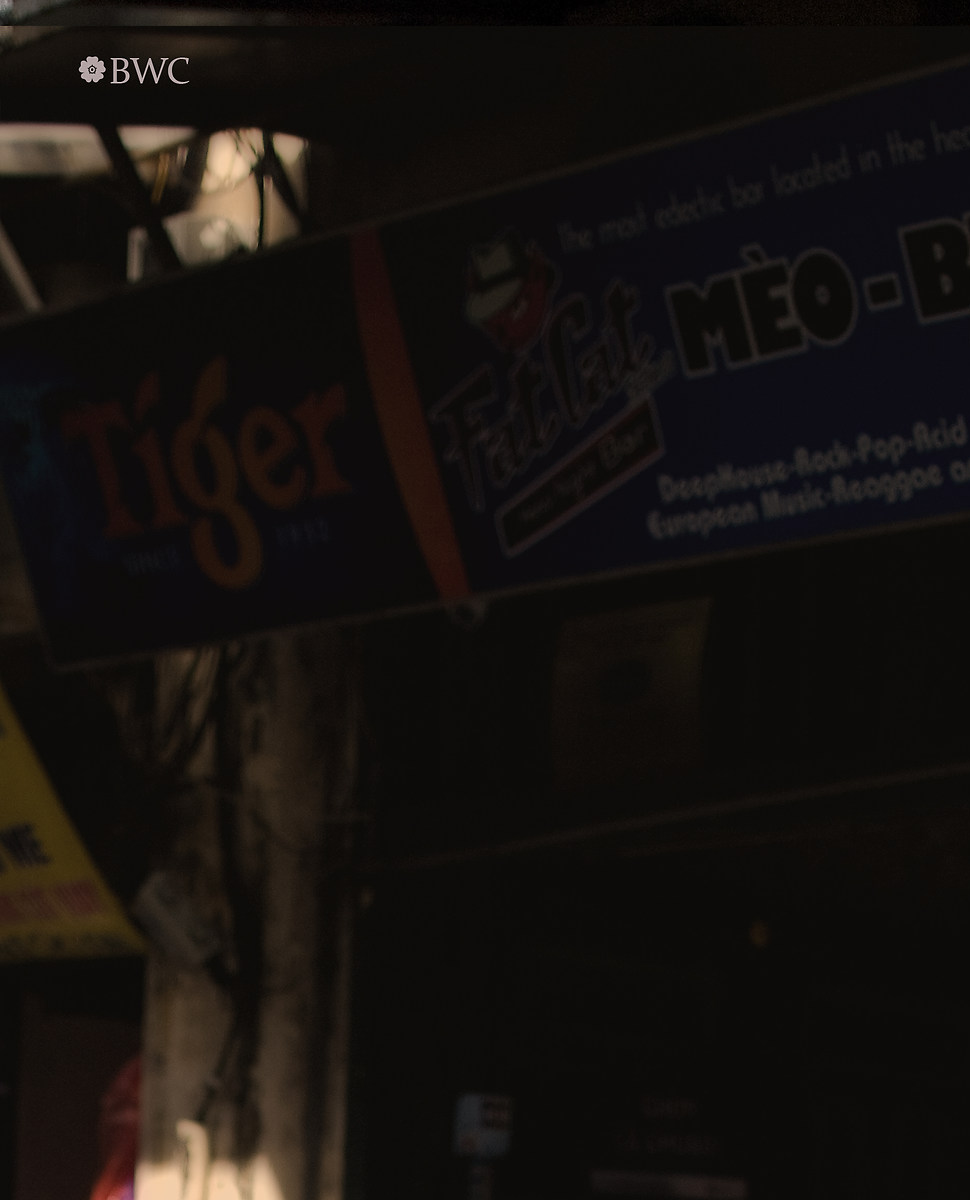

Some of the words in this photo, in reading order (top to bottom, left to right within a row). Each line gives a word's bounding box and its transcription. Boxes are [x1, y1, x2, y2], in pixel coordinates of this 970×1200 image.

[727, 175, 765, 210] bar
[770, 145, 852, 198] located
[857, 142, 883, 175] in
[886, 128, 927, 167] the
[59, 353, 354, 592] Tiger
[645, 499, 760, 540] European
